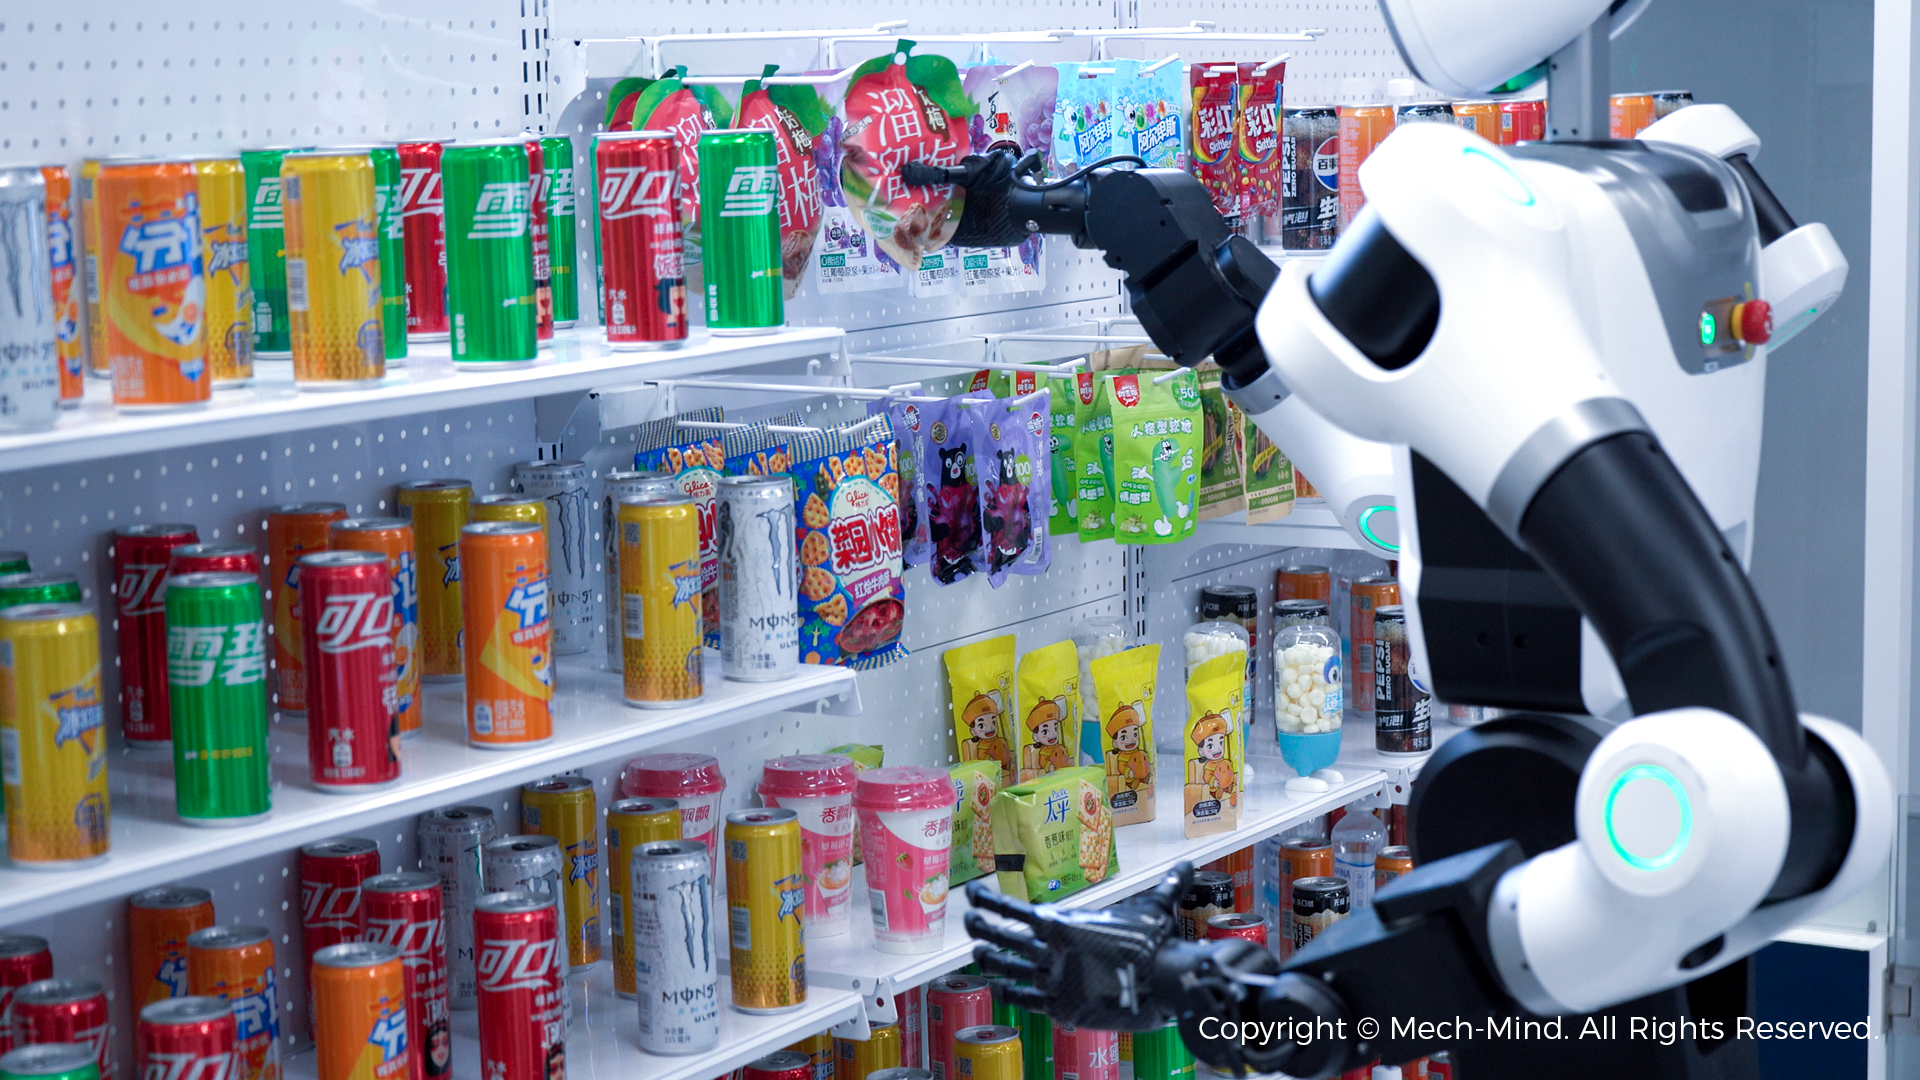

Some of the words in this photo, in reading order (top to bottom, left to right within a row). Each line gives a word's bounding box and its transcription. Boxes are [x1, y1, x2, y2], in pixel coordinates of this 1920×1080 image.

[866, 87, 922, 147] 溜
[1137, 115, 1177, 158] 阿尔卑斯
[1198, 104, 1233, 139] 彩虹
[1244, 103, 1278, 138] 彩虹
[1209, 139, 1233, 155] Skittles
[1255, 137, 1278, 154] Skittles
[1283, 136, 1291, 198] PEPSI
[467, 182, 532, 240] 雪
[720, 165, 778, 218] 雪
[964, 257, 987, 268] 0脂肪
[1131, 418, 1193, 438] 人格型软糖
[1015, 463, 1031, 476] 100
[830, 505, 902, 571] 菜园小饼
[853, 570, 891, 600] 红烩牛肉味
[316, 593, 395, 647] 可口
[168, 622, 266, 686] 雪碧
[1376, 640, 1386, 701] PEPSI
[1043, 794, 1071, 825] 太平
